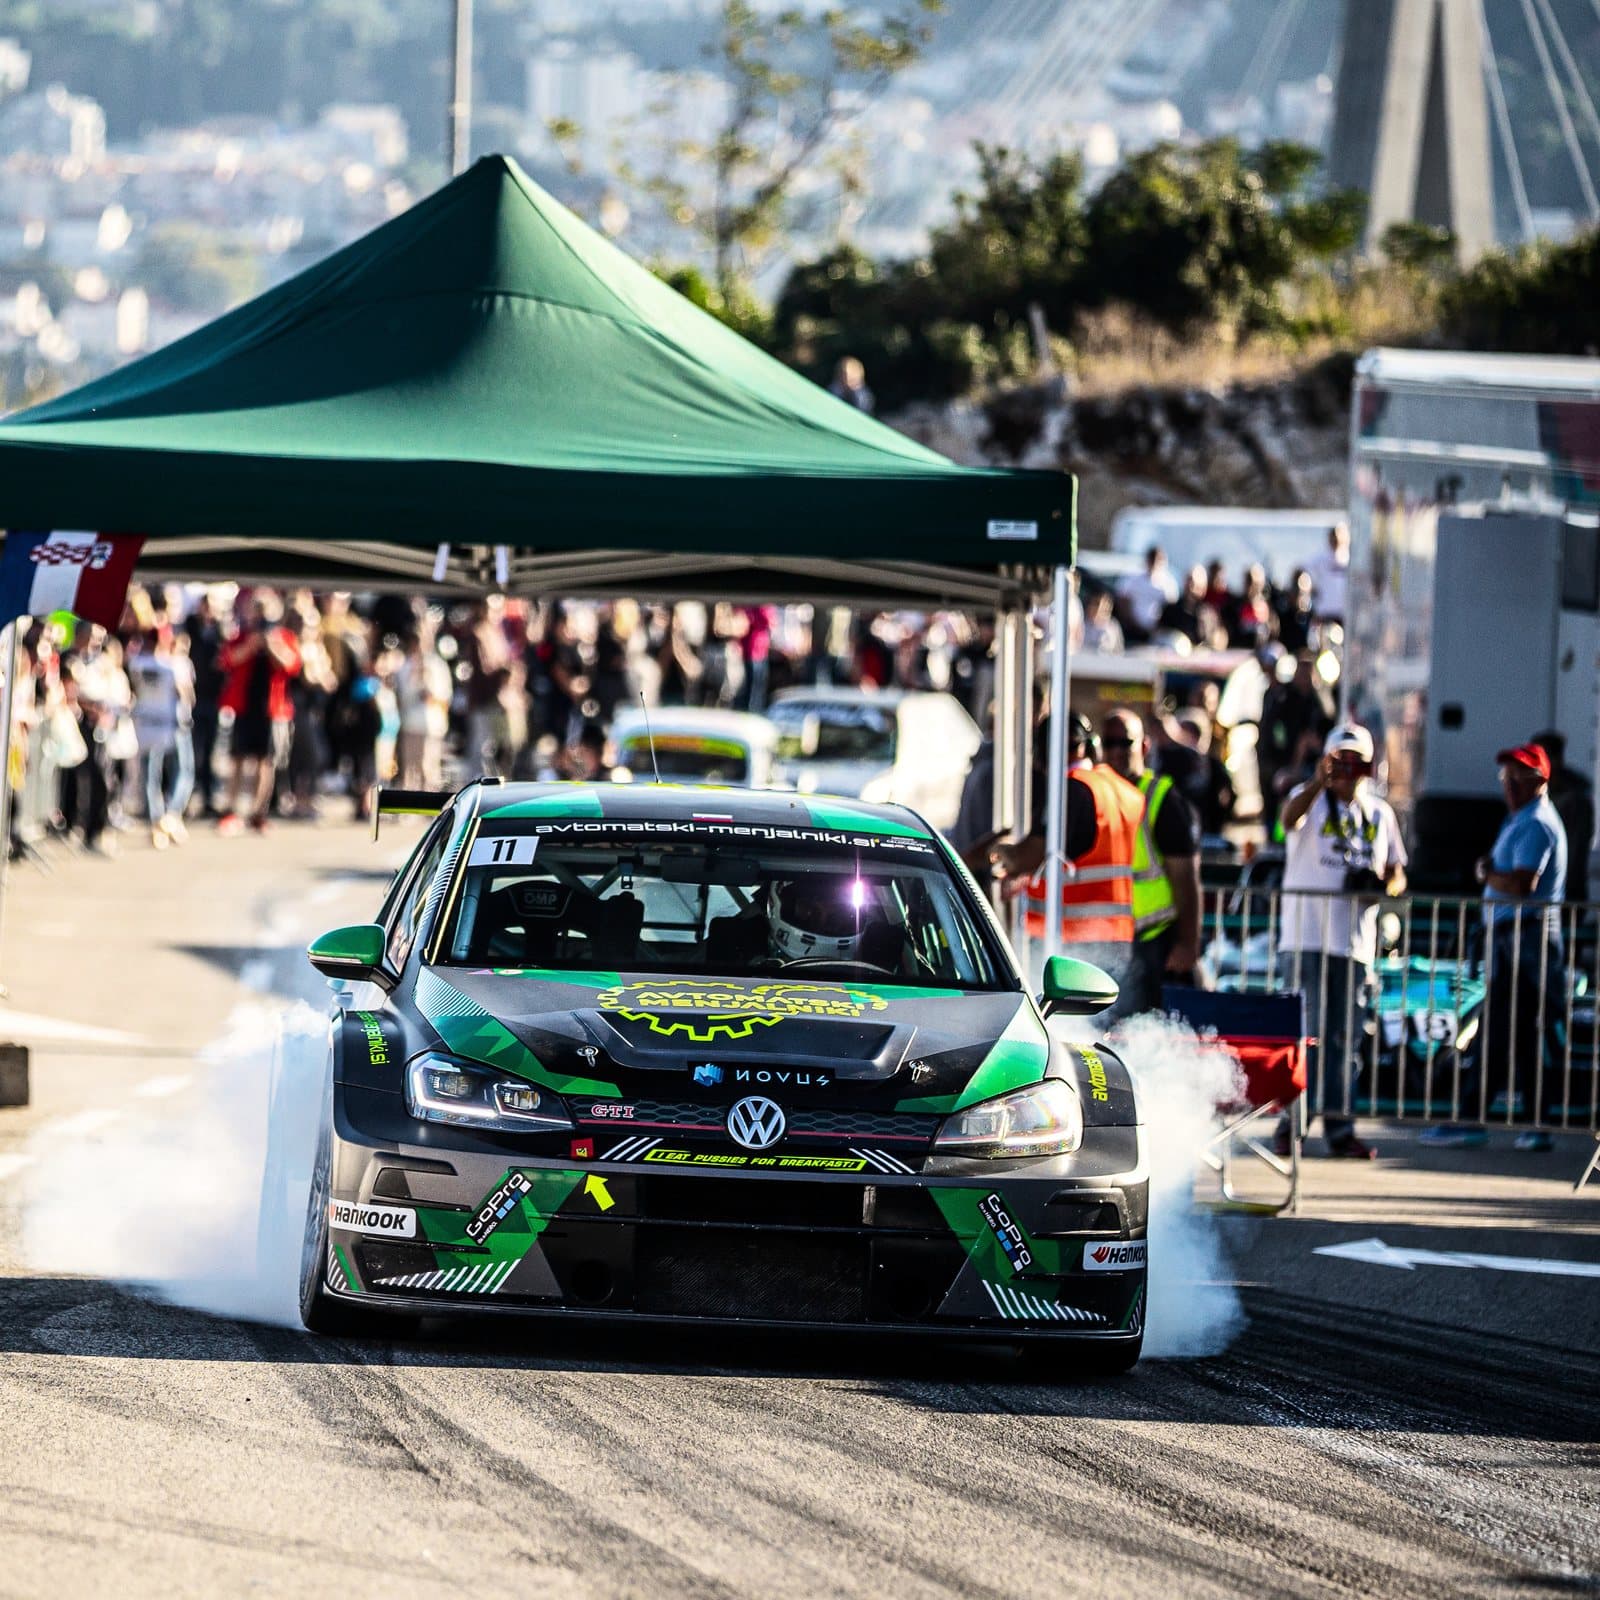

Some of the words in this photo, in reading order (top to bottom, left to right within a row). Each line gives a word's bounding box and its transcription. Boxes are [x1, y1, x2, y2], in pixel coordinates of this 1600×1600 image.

[535, 822, 875, 848] avtomatski-menjalniki.si
[492, 839, 518, 862] 11
[636, 991, 865, 1010] AVTOMATSKI
[639, 999, 860, 1017] MENJALNIKI
[736, 1069, 830, 1087] NOVUS
[591, 1104, 634, 1119] GTI
[666, 1153, 689, 1161] EAT
[694, 1154, 748, 1165] PUSSIES
[750, 1157, 776, 1166] FOR
[779, 1159, 855, 1168] BREAKFAST!
[466, 1173, 523, 1236] GoPro
[988, 1194, 1031, 1265] GoPro
